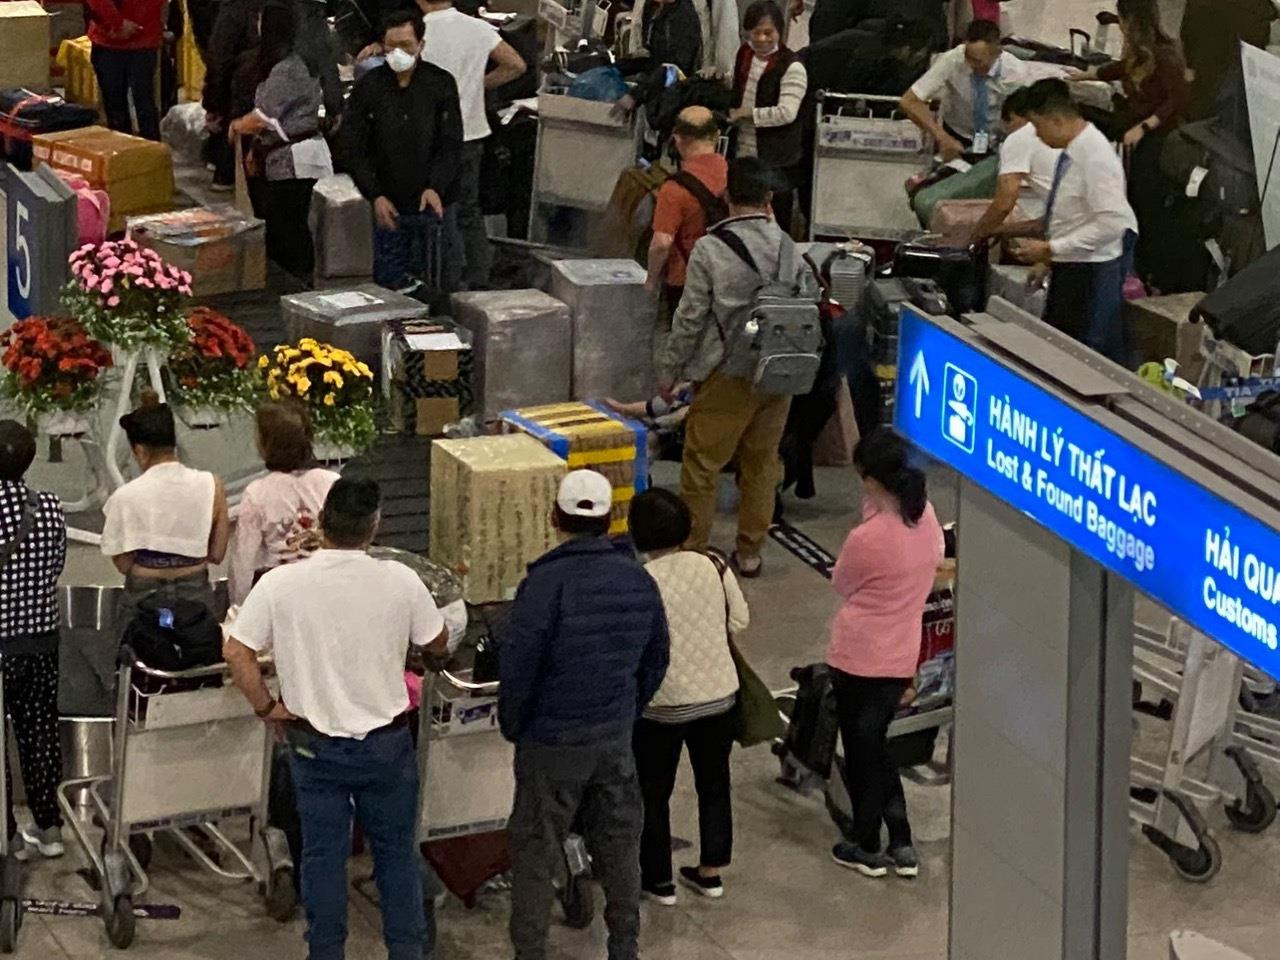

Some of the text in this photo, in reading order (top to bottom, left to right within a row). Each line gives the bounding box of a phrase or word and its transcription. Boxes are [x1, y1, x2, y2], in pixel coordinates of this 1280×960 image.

[15, 200, 31, 300] 5
[987, 437, 1156, 572] Lost & Found Baggage
[989, 394, 1157, 527] HÀNH LÝ THẤT LẠC
[1205, 525, 1240, 581] HẢI
[1203, 575, 1278, 651] Customs
